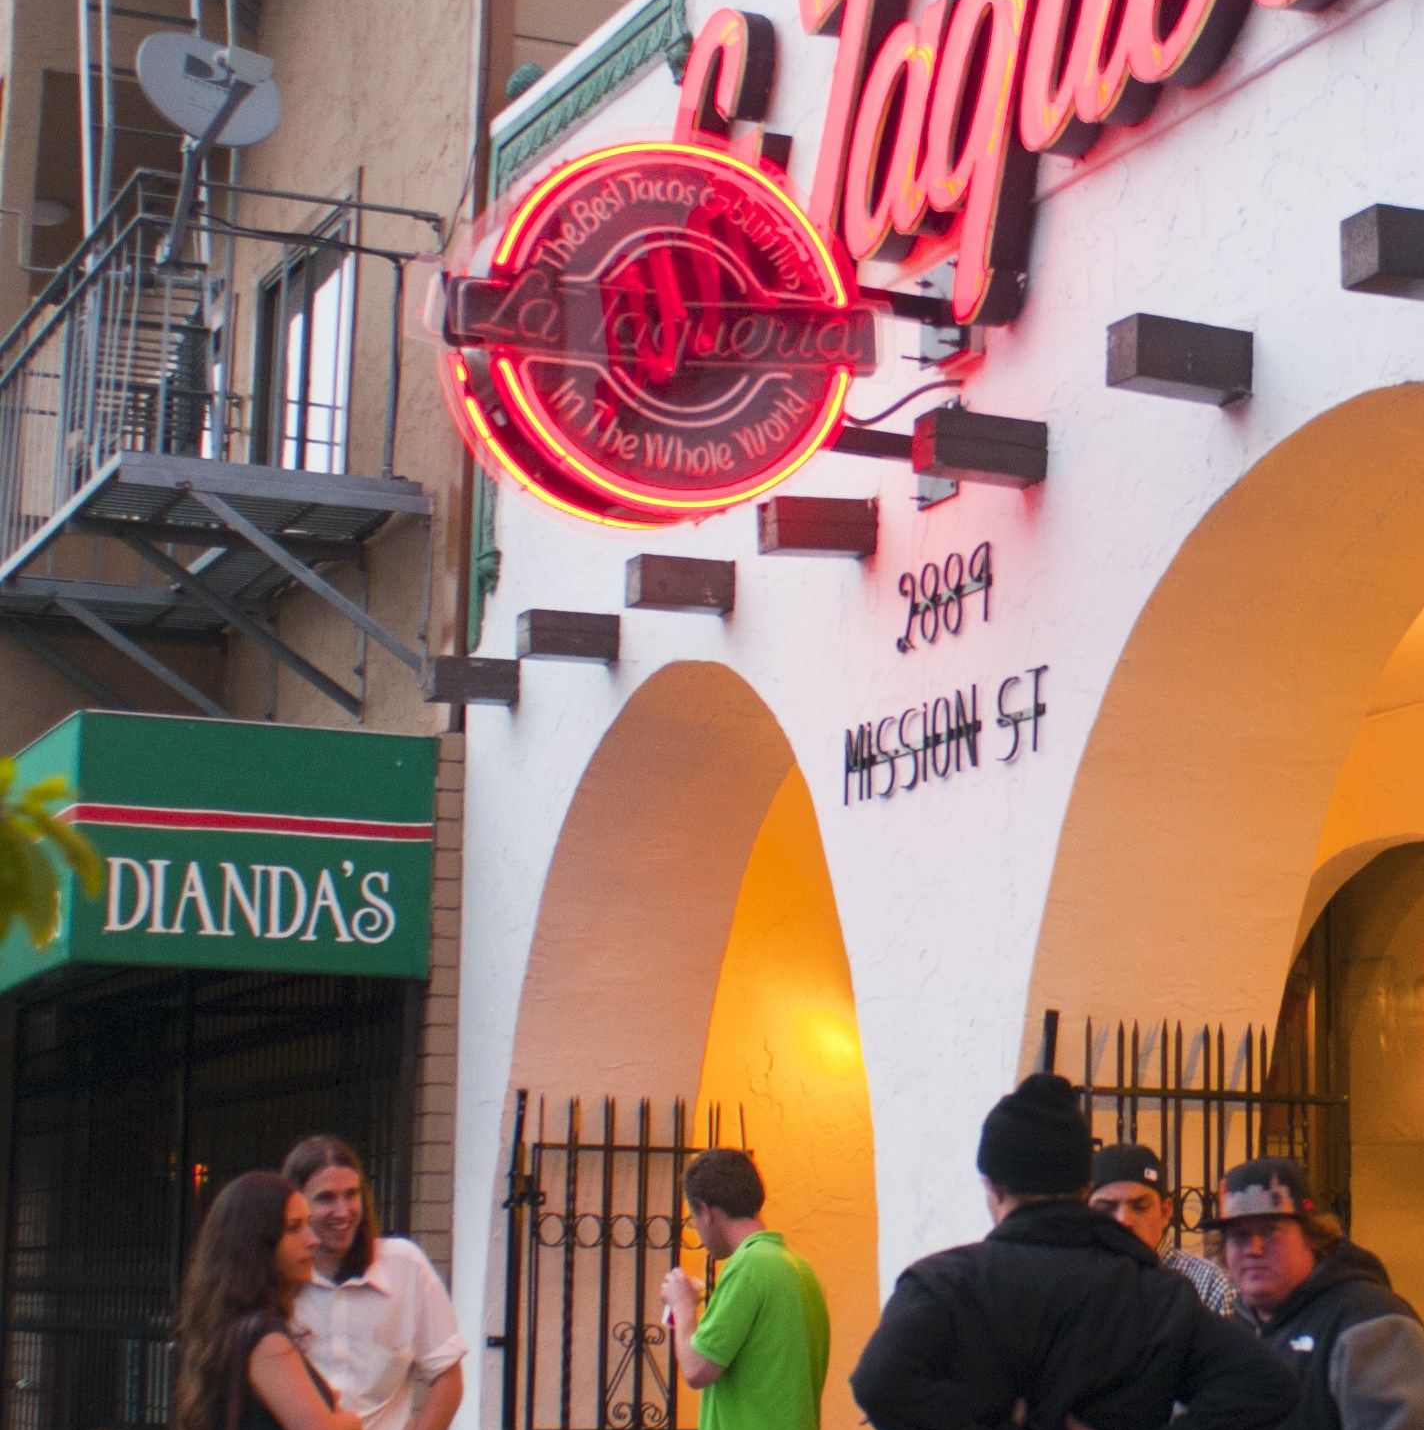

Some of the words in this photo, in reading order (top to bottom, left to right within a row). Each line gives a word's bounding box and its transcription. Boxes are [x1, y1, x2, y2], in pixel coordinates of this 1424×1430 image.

[530, 222, 587, 271] The
[569, 173, 627, 238] Best
[617, 170, 697, 208] Tacos
[468, 269, 560, 343] La
[590, 283, 866, 373] Taqueria
[549, 377, 587, 422] In
[584, 398, 640, 461] The
[642, 431, 735, 477] Whole
[730, 386, 811, 460] World
[896, 540, 993, 655] 2889
[997, 663, 1049, 762] ST
[103, 856, 397, 944] DIANDA'S
